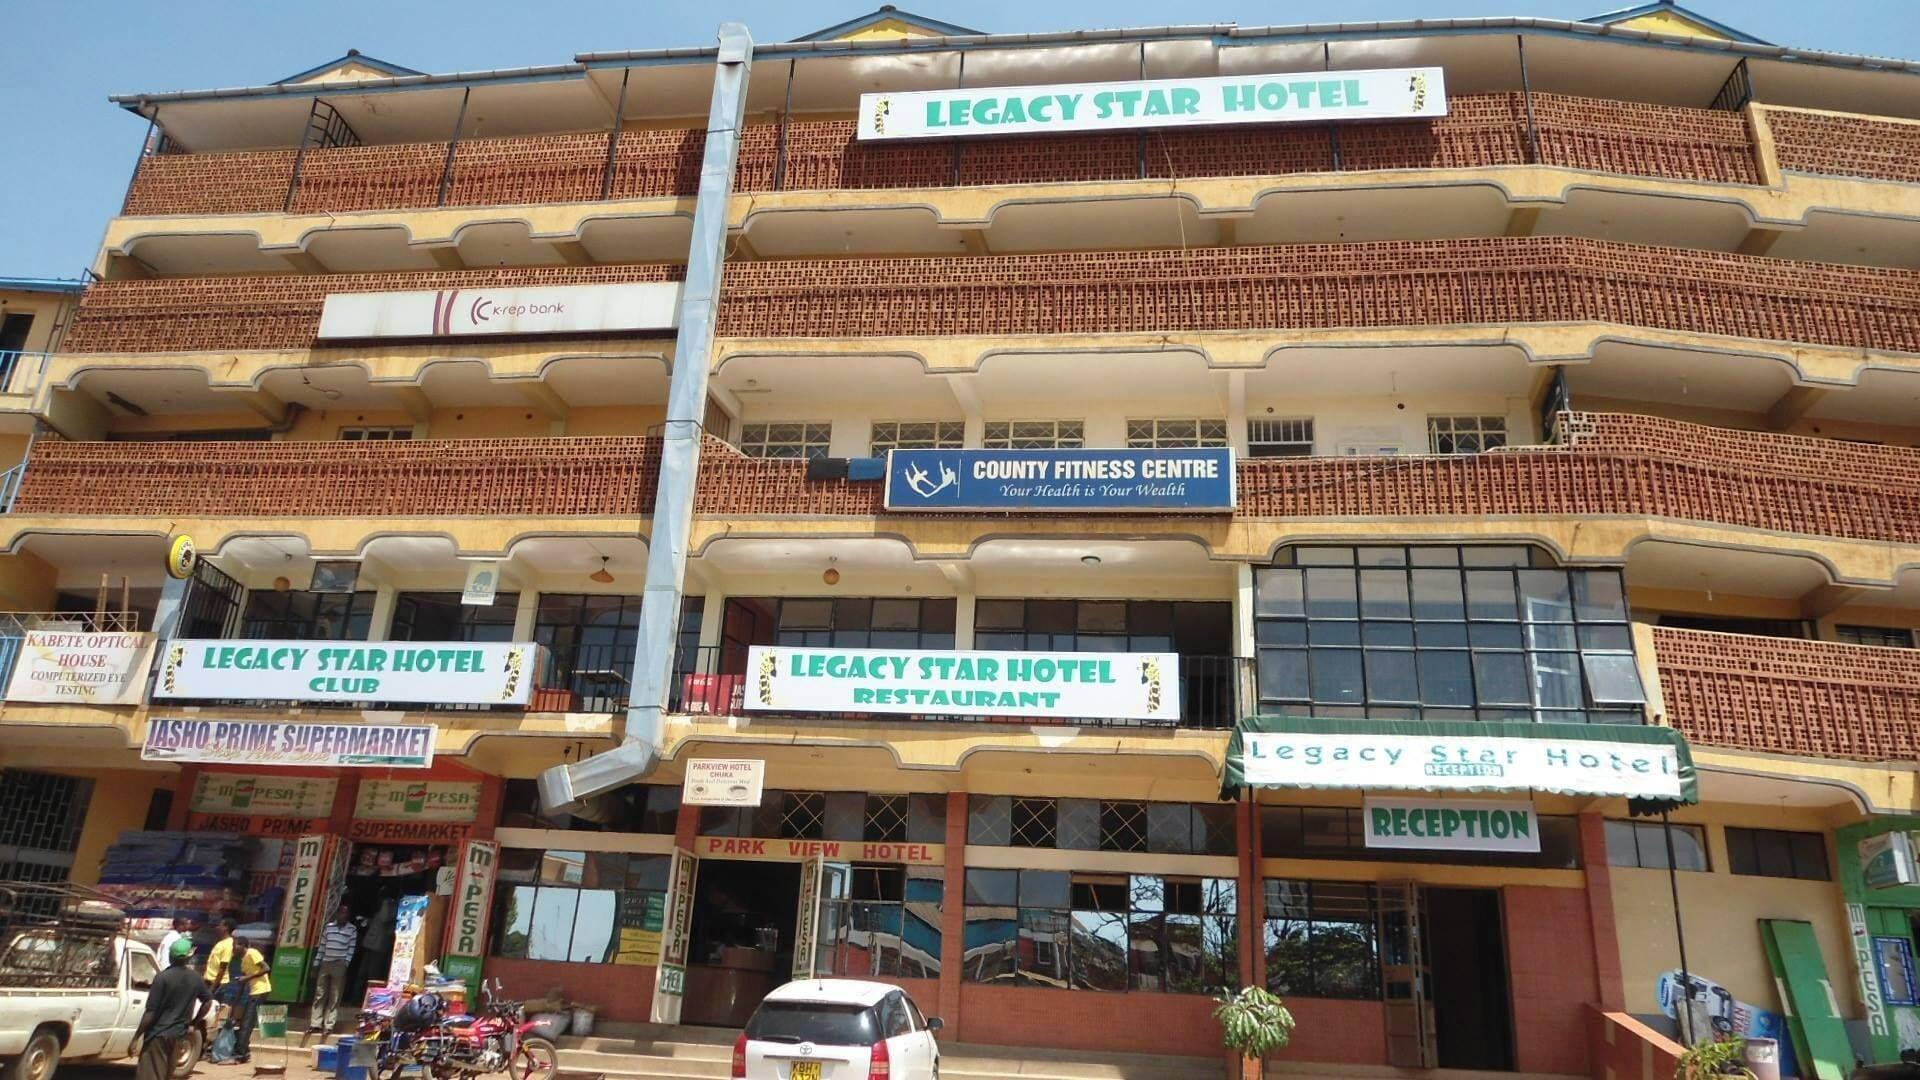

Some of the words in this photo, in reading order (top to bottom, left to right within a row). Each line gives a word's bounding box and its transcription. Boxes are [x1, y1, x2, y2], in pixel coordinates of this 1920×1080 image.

[926, 94, 1083, 128] LEGACY
[1093, 88, 1201, 119] STAR
[1222, 79, 1369, 112] HOTEL
[529, 302, 565, 315] bank
[973, 460, 1050, 479] COUNTY
[1055, 459, 1135, 479] FITNESS
[1141, 459, 1218, 479] CENTRE
[999, 484, 1034, 497] Your
[1034, 484, 1081, 497] Health
[1084, 485, 1095, 496] is
[1099, 484, 1134, 497] Your
[1136, 482, 1185, 497] Wealth
[27, 634, 84, 648] KABETE
[87, 635, 149, 649] OPTICAL
[58, 654, 108, 668] HOUSE
[203, 648, 308, 670] LEGACY
[317, 649, 387, 671] STAR
[392, 649, 486, 673] HOTEL
[790, 654, 911, 680] LEGACY
[918, 657, 1000, 682] STAR
[1008, 658, 1116, 684] HOTEL
[30, 671, 107, 682] COMPUTERIZED
[108, 673, 127, 683] EYE
[309, 677, 380, 693] CLUB
[55, 685, 97, 695] TESTING
[853, 688, 1060, 708] RESTAURANT
[147, 719, 211, 749] JASHO
[213, 724, 279, 752] PRIME
[282, 725, 431, 756] SUPERMARKET
[1251, 740, 1403, 765] Legacy
[1431, 745, 1519, 763] Star
[1547, 748, 1671, 775] Hotel
[693, 763, 728, 771] PARKVIEW
[730, 763, 752, 771] HOTEL
[1425, 764, 1503, 776] RECEPTION
[262, 818, 314, 834] PRIME
[352, 822, 472, 840] SUPERMARKET
[1371, 807, 1530, 840] RECEPTION
[709, 838, 767, 855] PARK
[789, 841, 840, 858] VIEW
[863, 844, 934, 861] HOTEL
